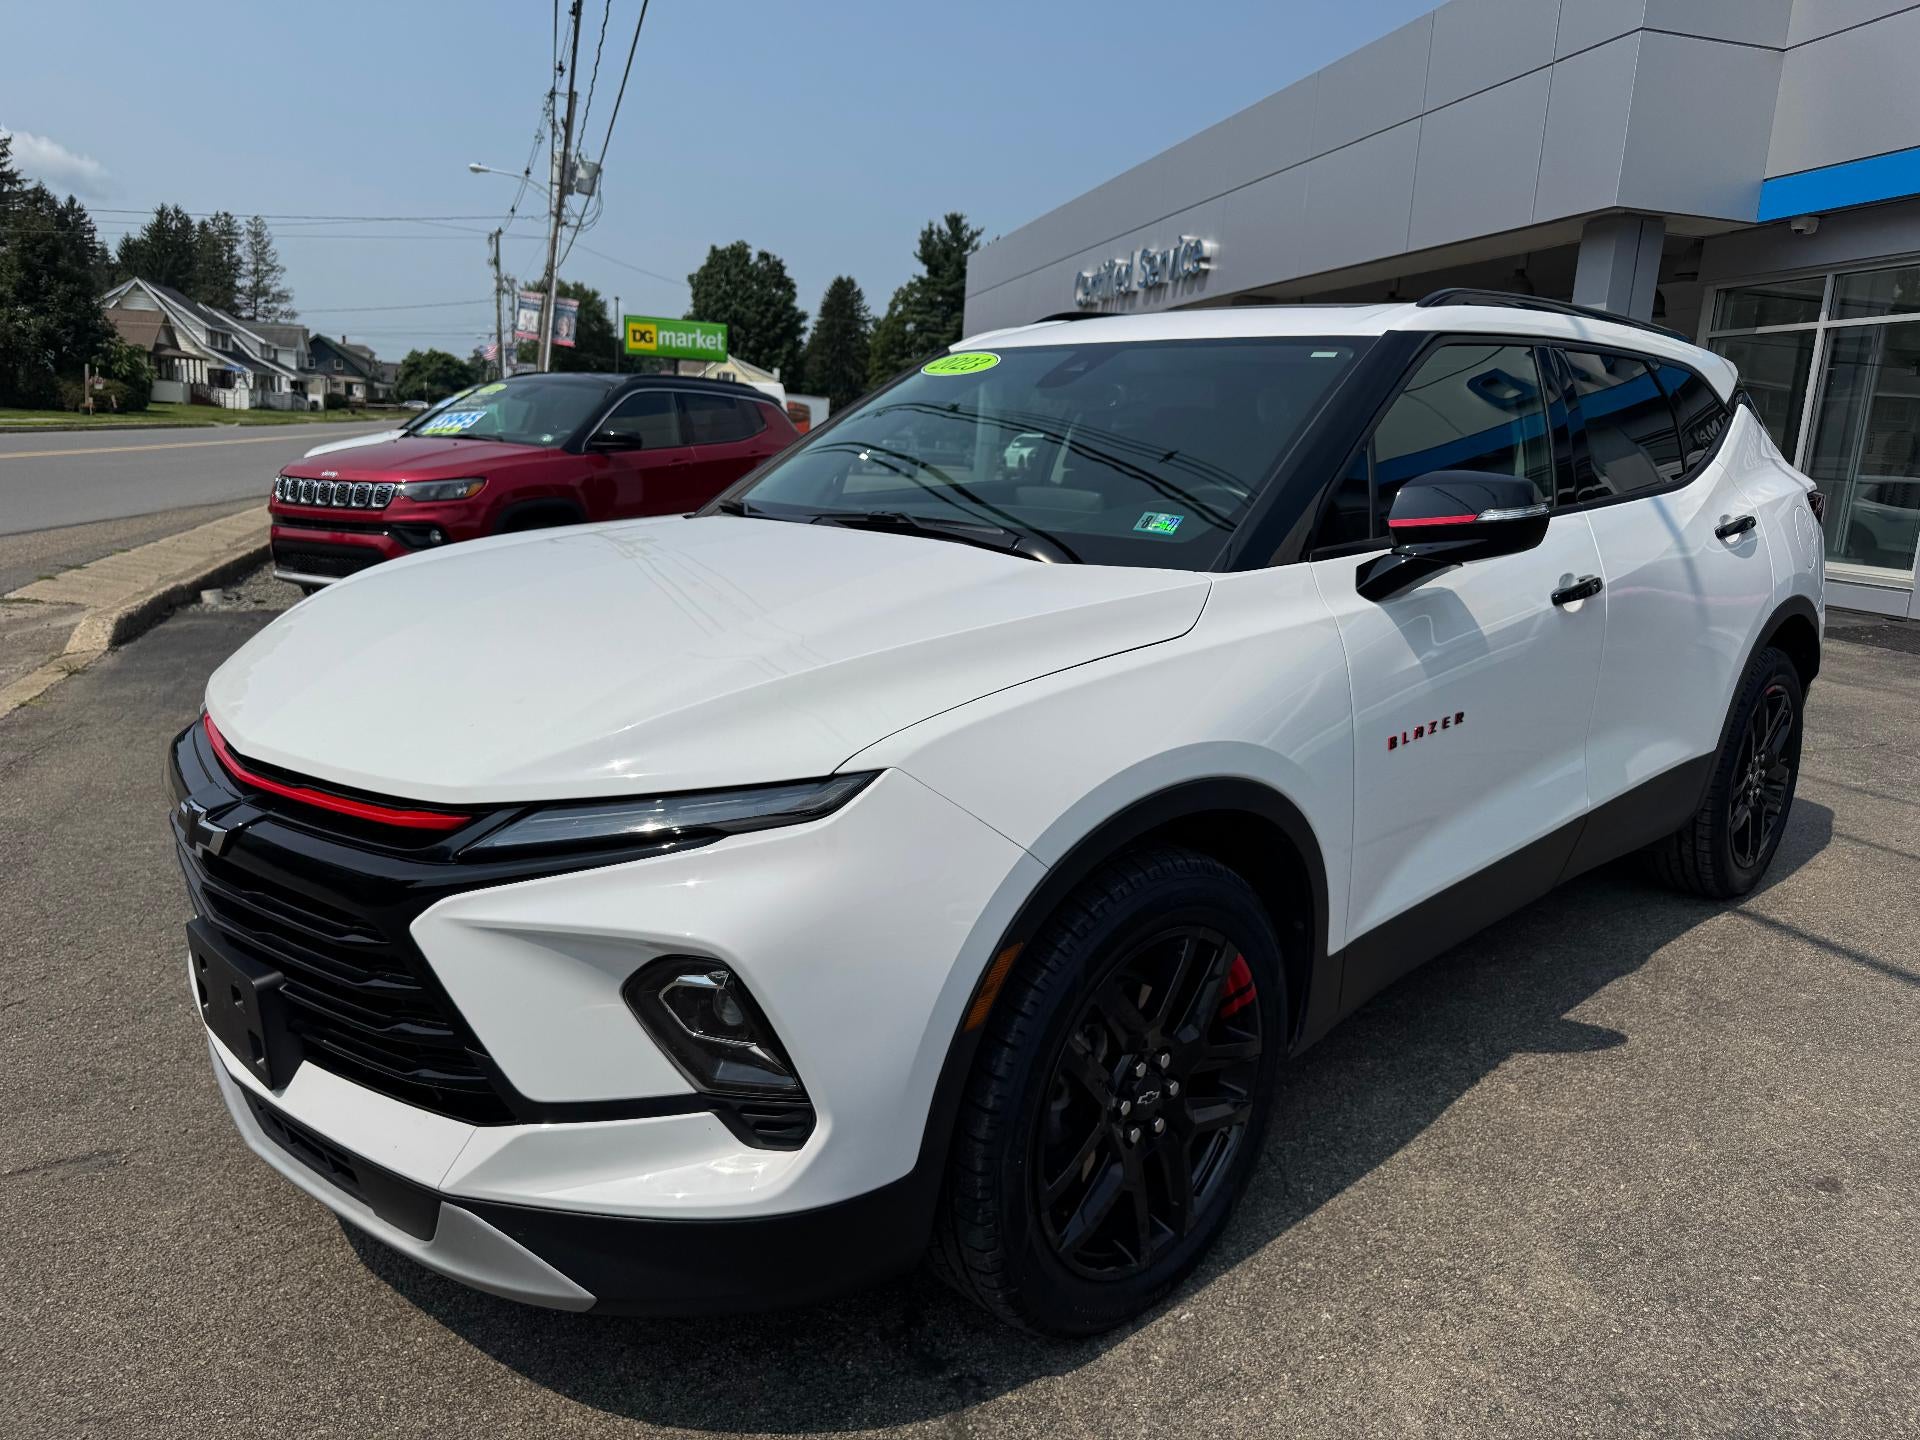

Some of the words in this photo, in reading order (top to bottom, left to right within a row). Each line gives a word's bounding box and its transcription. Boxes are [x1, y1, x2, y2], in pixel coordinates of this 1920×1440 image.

[1137, 234, 1211, 289] Service
[632, 329, 654, 344] DG
[658, 328, 724, 351] market
[1387, 711, 1465, 752] BLAZER
